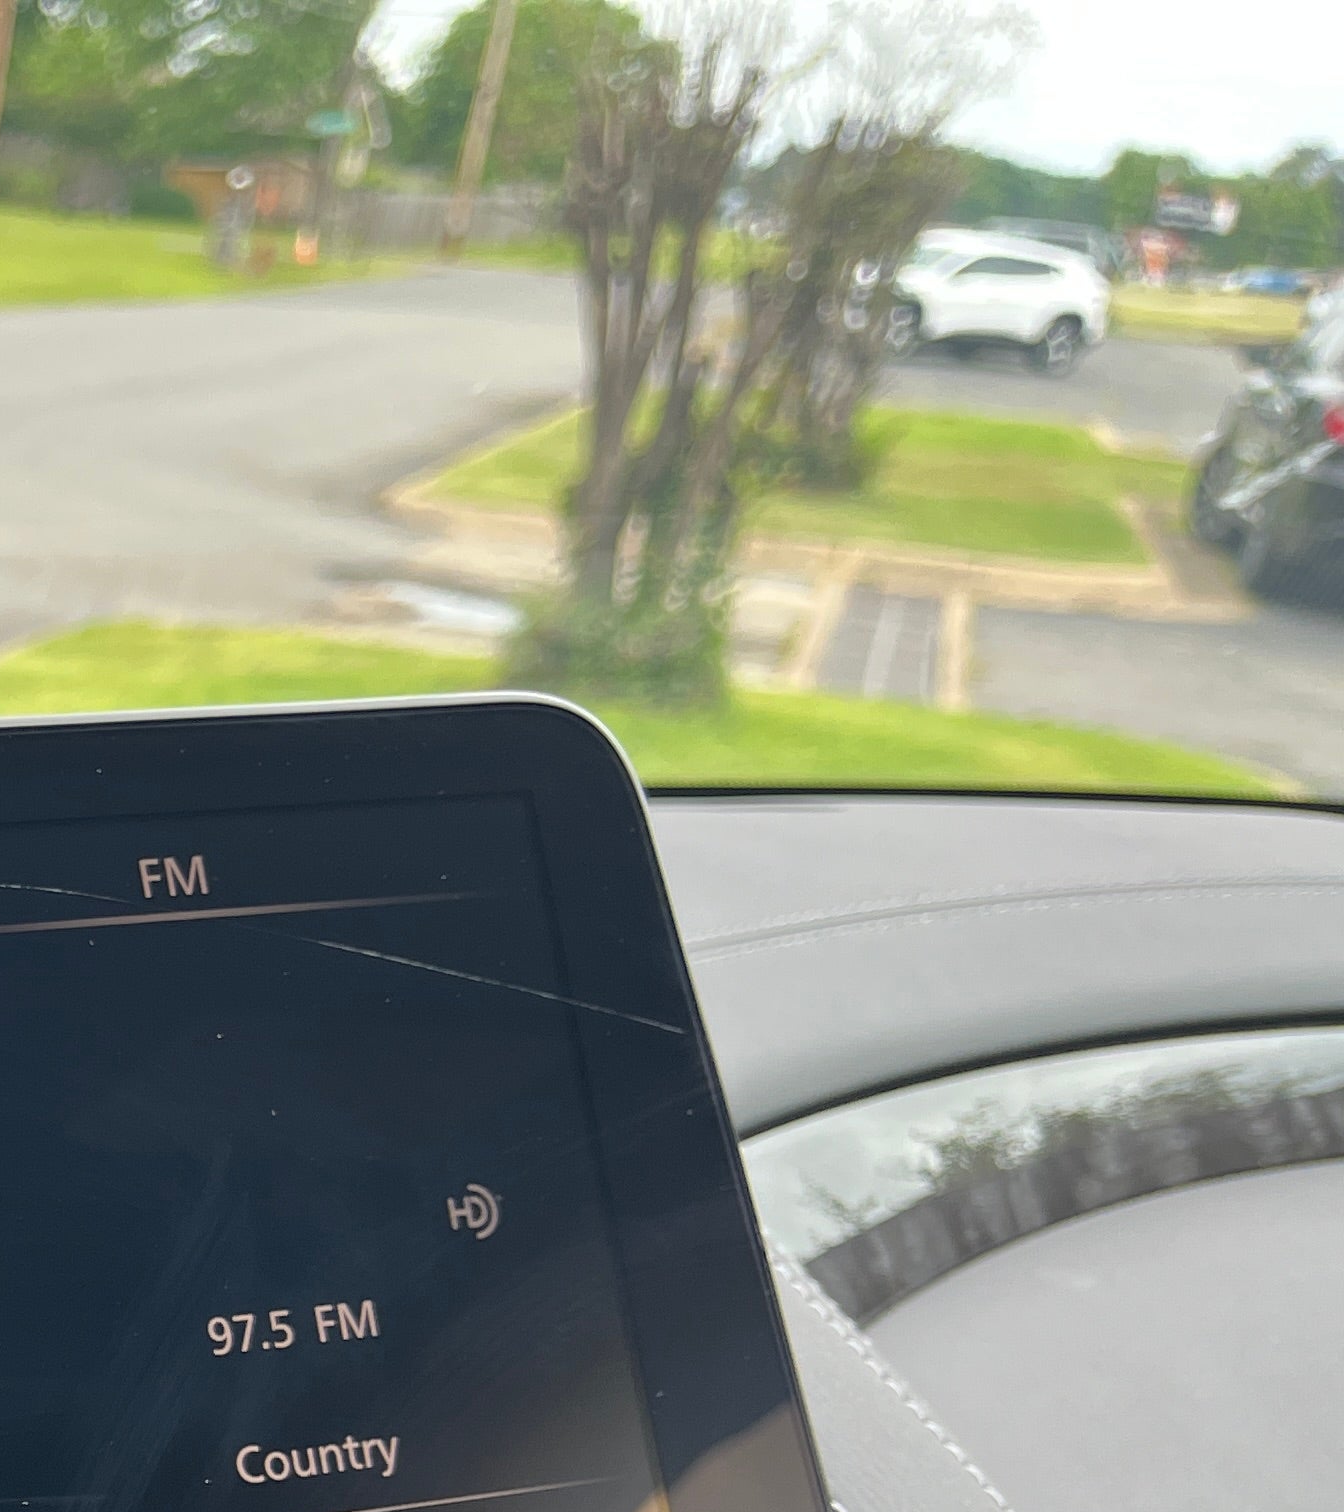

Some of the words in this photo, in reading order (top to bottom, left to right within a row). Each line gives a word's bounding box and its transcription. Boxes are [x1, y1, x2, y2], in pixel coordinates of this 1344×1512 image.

[137, 854, 210, 899] FM
[206, 1308, 295, 1356] 97.5
[313, 1300, 381, 1343] FM
[234, 1435, 400, 1485] Country
